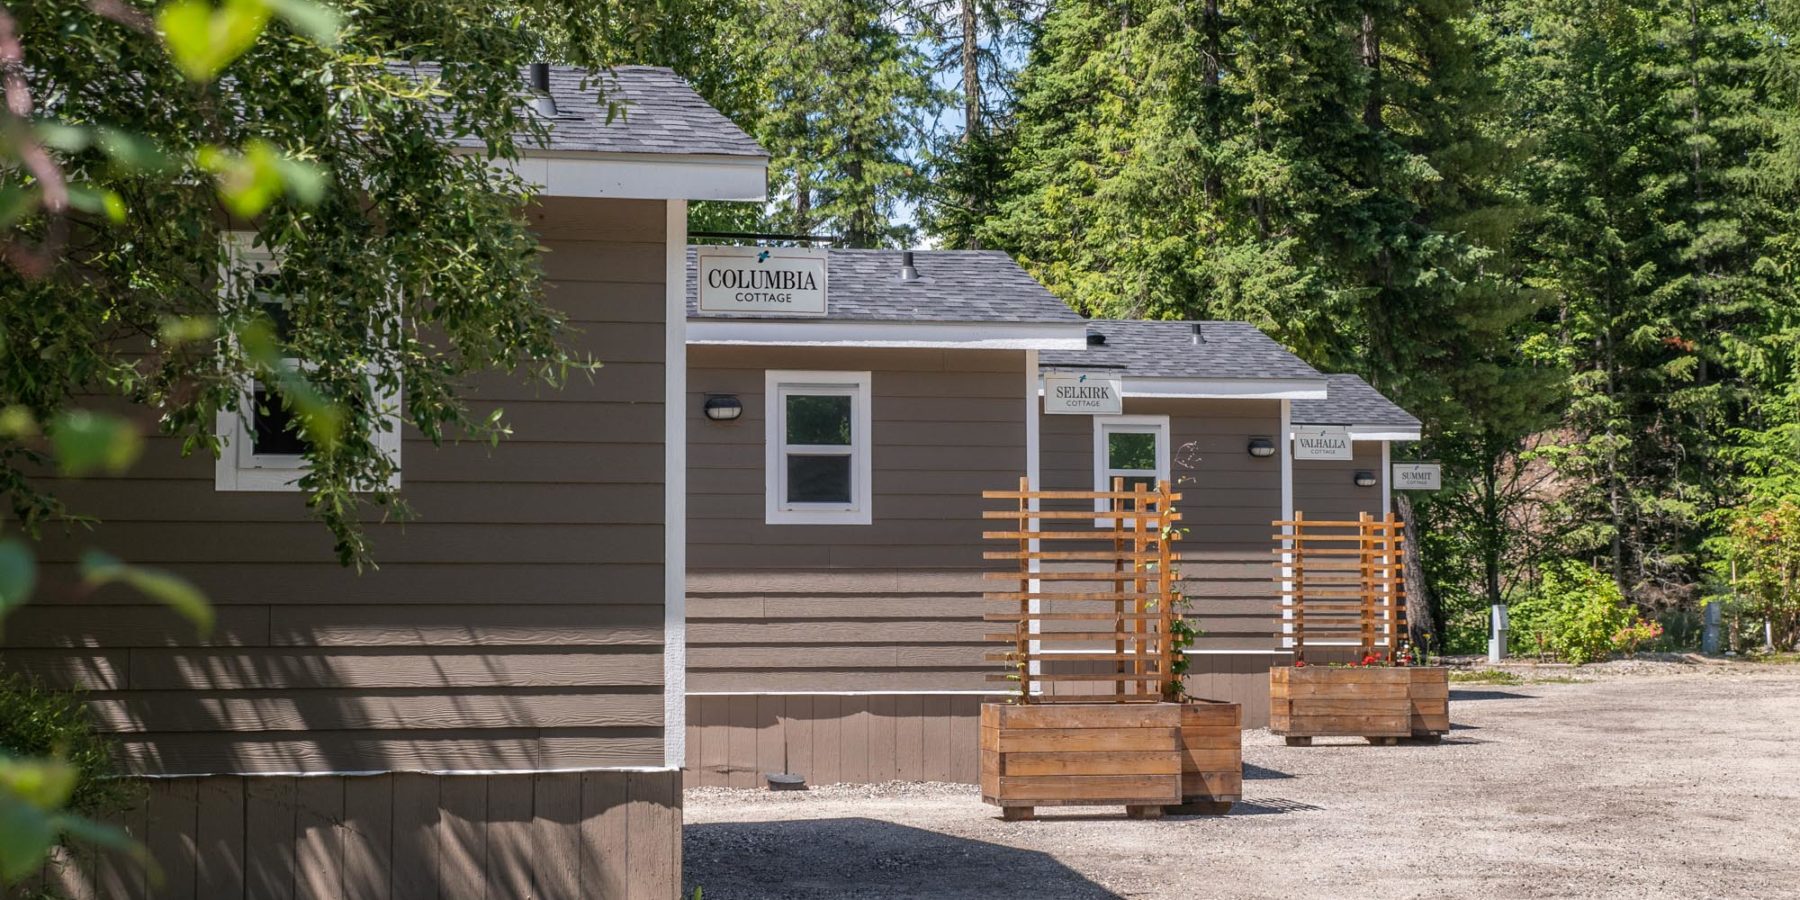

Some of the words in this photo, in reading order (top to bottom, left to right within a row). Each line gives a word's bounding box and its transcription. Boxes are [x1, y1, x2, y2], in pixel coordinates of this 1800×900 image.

[708, 268, 818, 290] COLUMBIA
[735, 292, 792, 303] COTTAGE
[1056, 385, 1109, 399] SELKIRK
[1300, 438, 1346, 448] VALHALLA
[1402, 472, 1432, 480] SUMMIT
